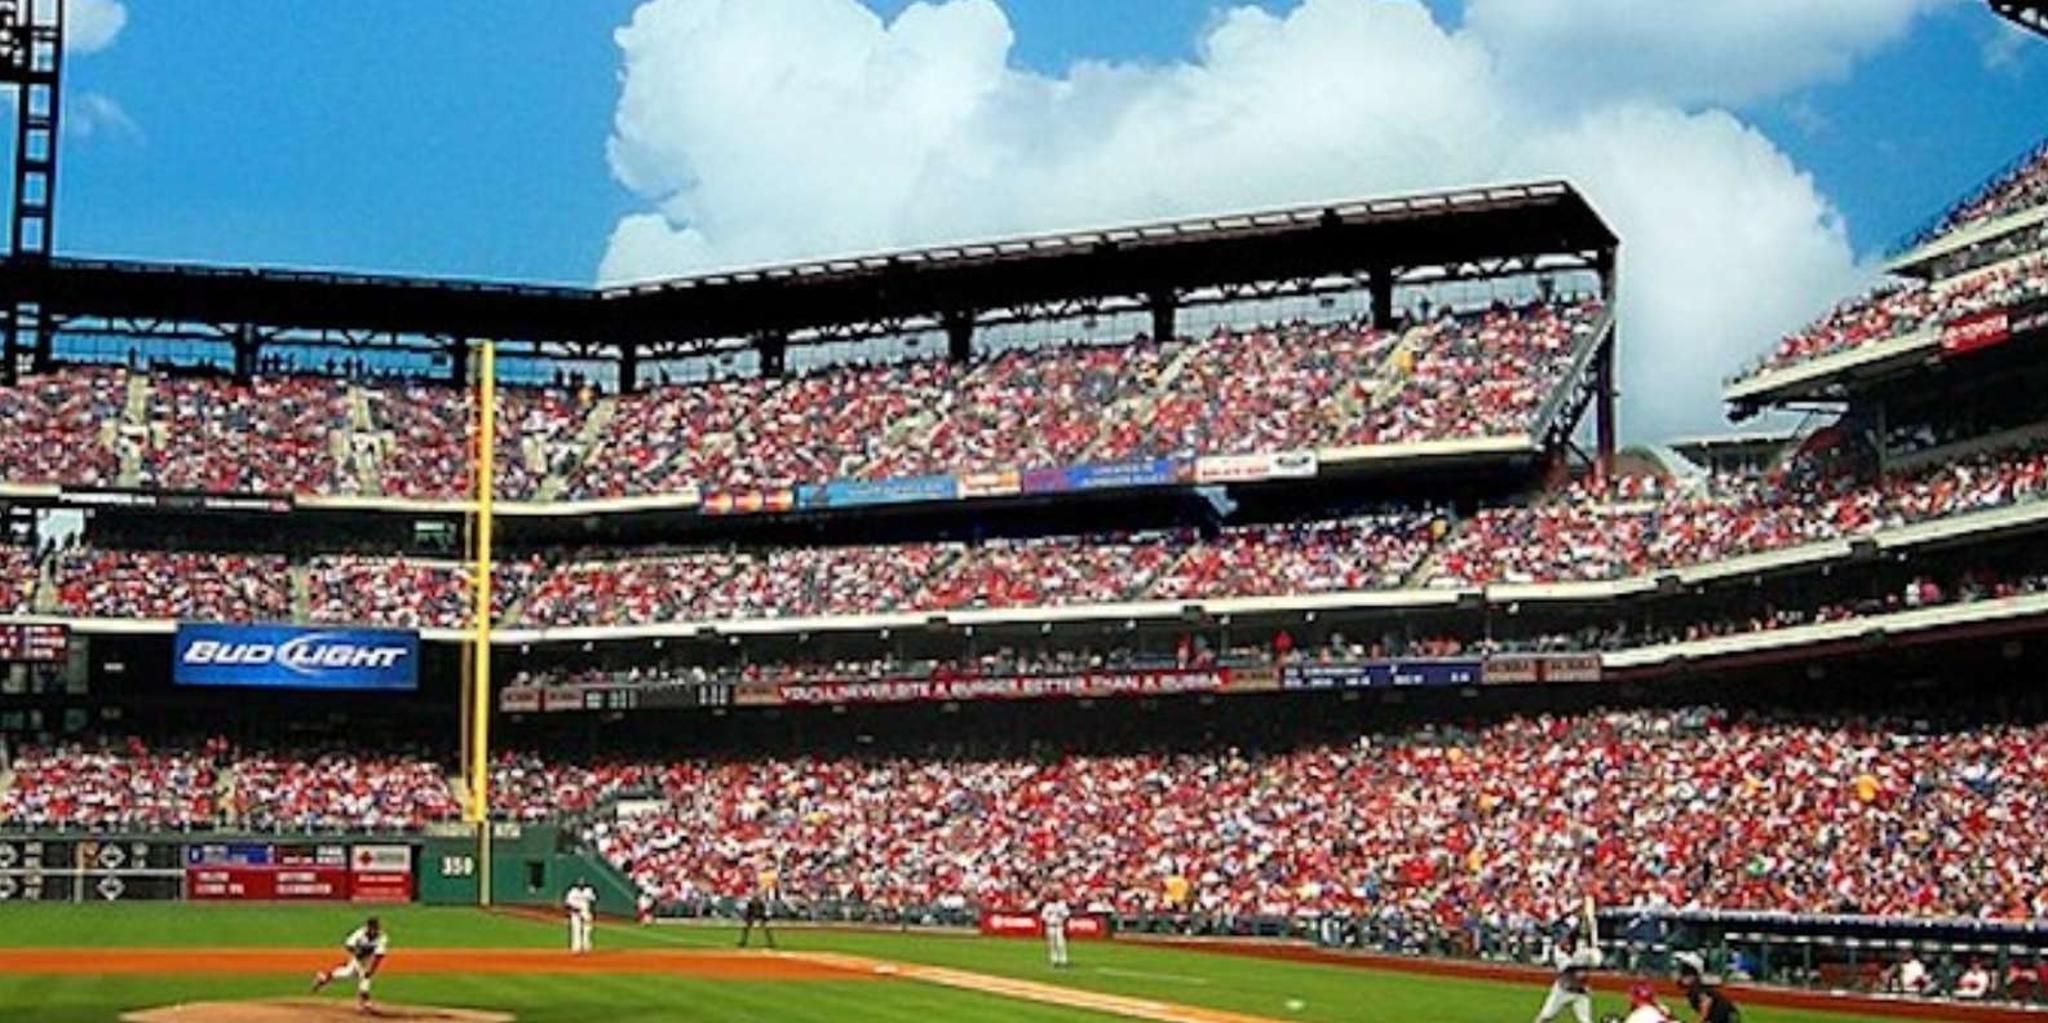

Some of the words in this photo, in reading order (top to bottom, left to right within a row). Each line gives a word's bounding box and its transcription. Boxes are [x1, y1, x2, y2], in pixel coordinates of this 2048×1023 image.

[183, 640, 275, 664] BUD
[294, 644, 407, 667] LIGHT
[442, 856, 474, 876] 350
